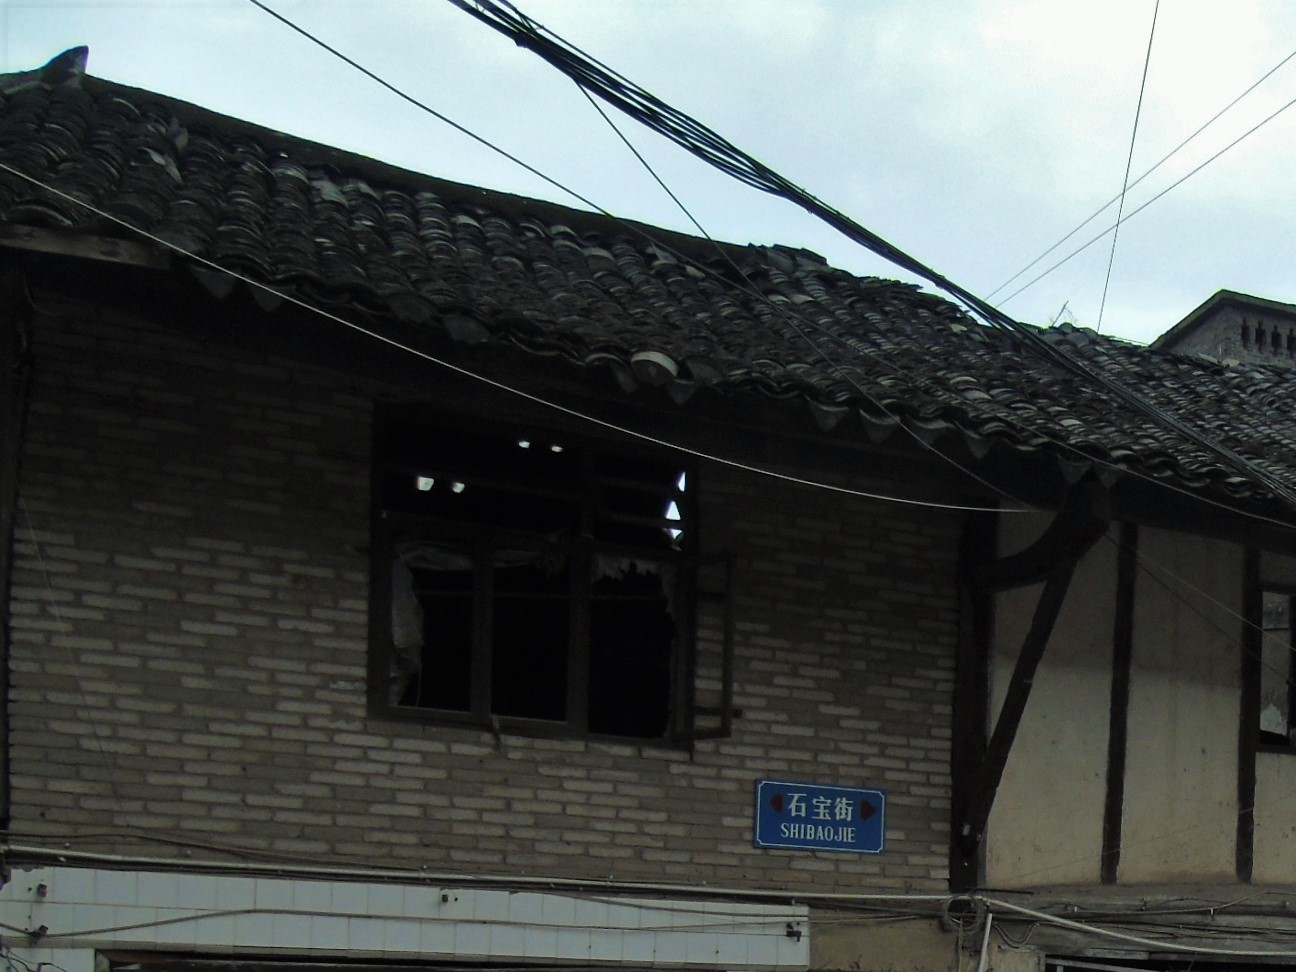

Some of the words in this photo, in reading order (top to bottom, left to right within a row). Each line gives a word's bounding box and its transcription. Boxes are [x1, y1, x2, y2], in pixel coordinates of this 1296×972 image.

[787, 793, 854, 821] 石宝街
[780, 823, 856, 842] SHIBAOJIE
